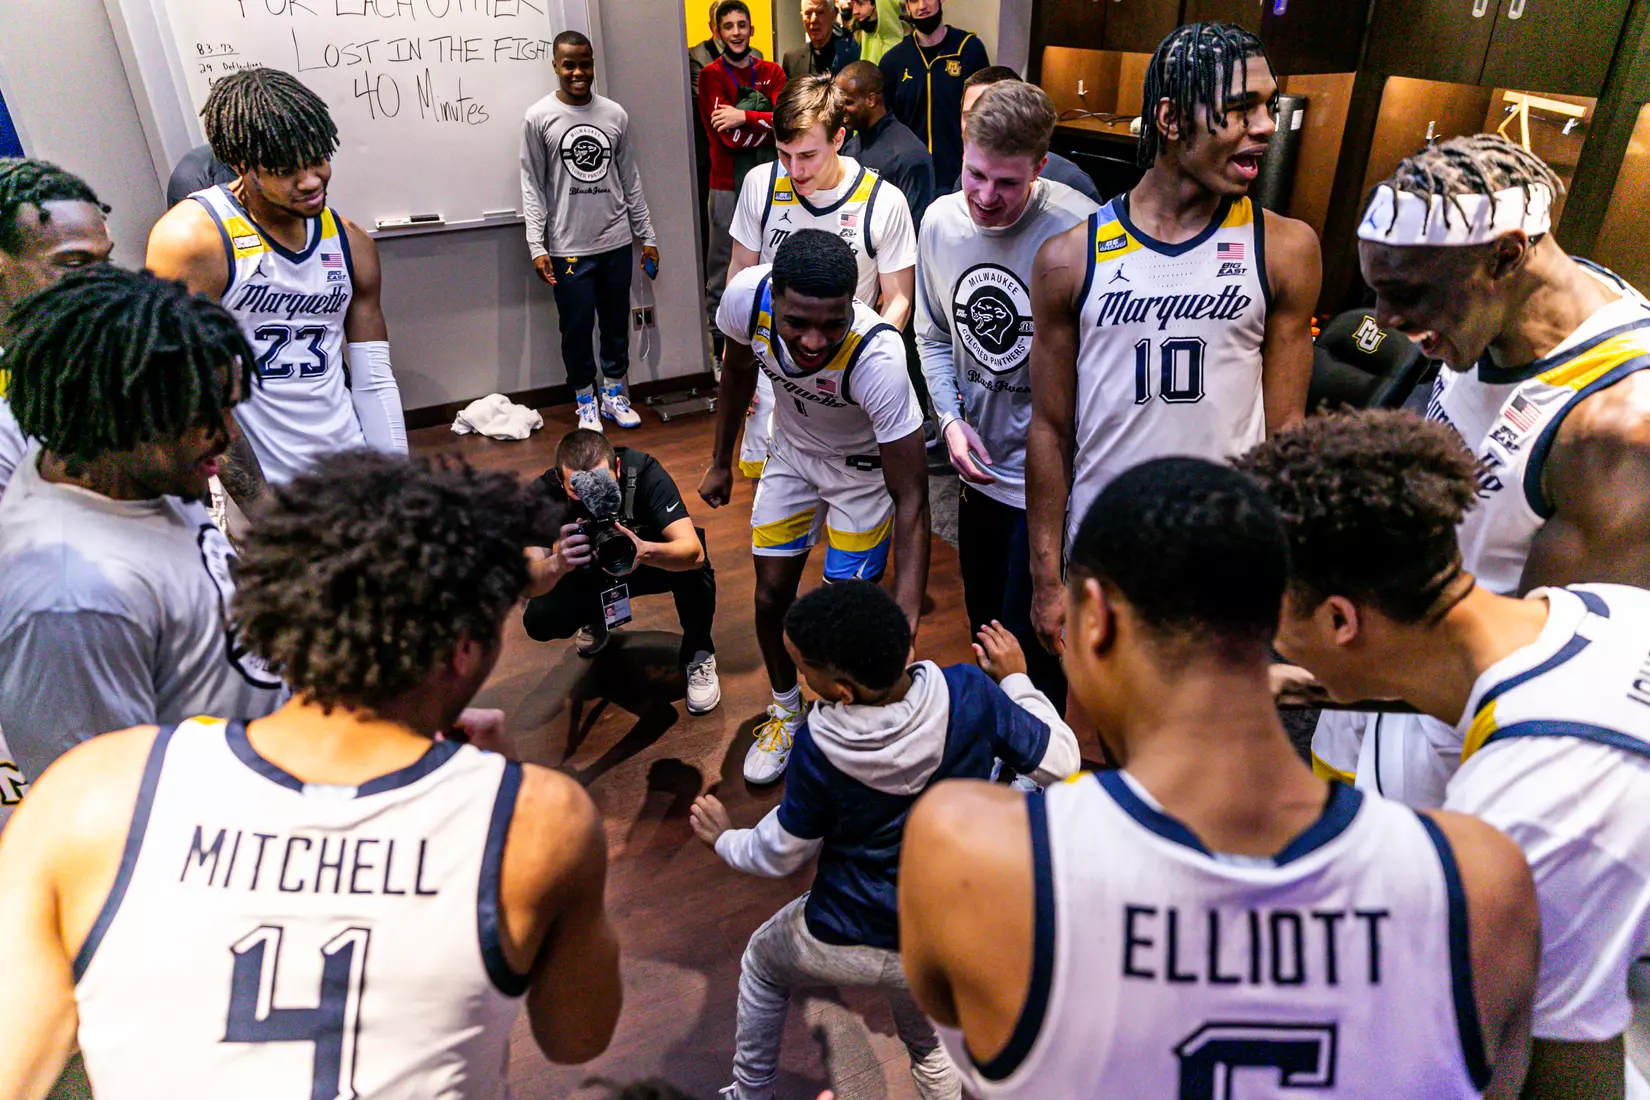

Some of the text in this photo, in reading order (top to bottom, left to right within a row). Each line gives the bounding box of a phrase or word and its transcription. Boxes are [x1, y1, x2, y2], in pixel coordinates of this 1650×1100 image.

[199, 63, 213, 74] 29
[291, 27, 552, 72] LOST IN THE FIGHT
[354, 68, 490, 126] 40 Minutes
[570, 128, 602, 138] MILWAUKEE
[968, 272, 1020, 296] MILWAUKEE
[1217, 268, 1248, 277] EAST
[233, 284, 348, 320] Marquette
[1096, 285, 1252, 330] Marquette
[254, 324, 329, 379] 23
[962, 328, 1026, 366] COLORED PANTHERS
[1354, 317, 1384, 352] MU
[1134, 336, 1207, 405] 10
[179, 825, 439, 896] MITCHELL
[1122, 903, 1391, 986] ELLIOTT
[217, 925, 371, 1100] 4
